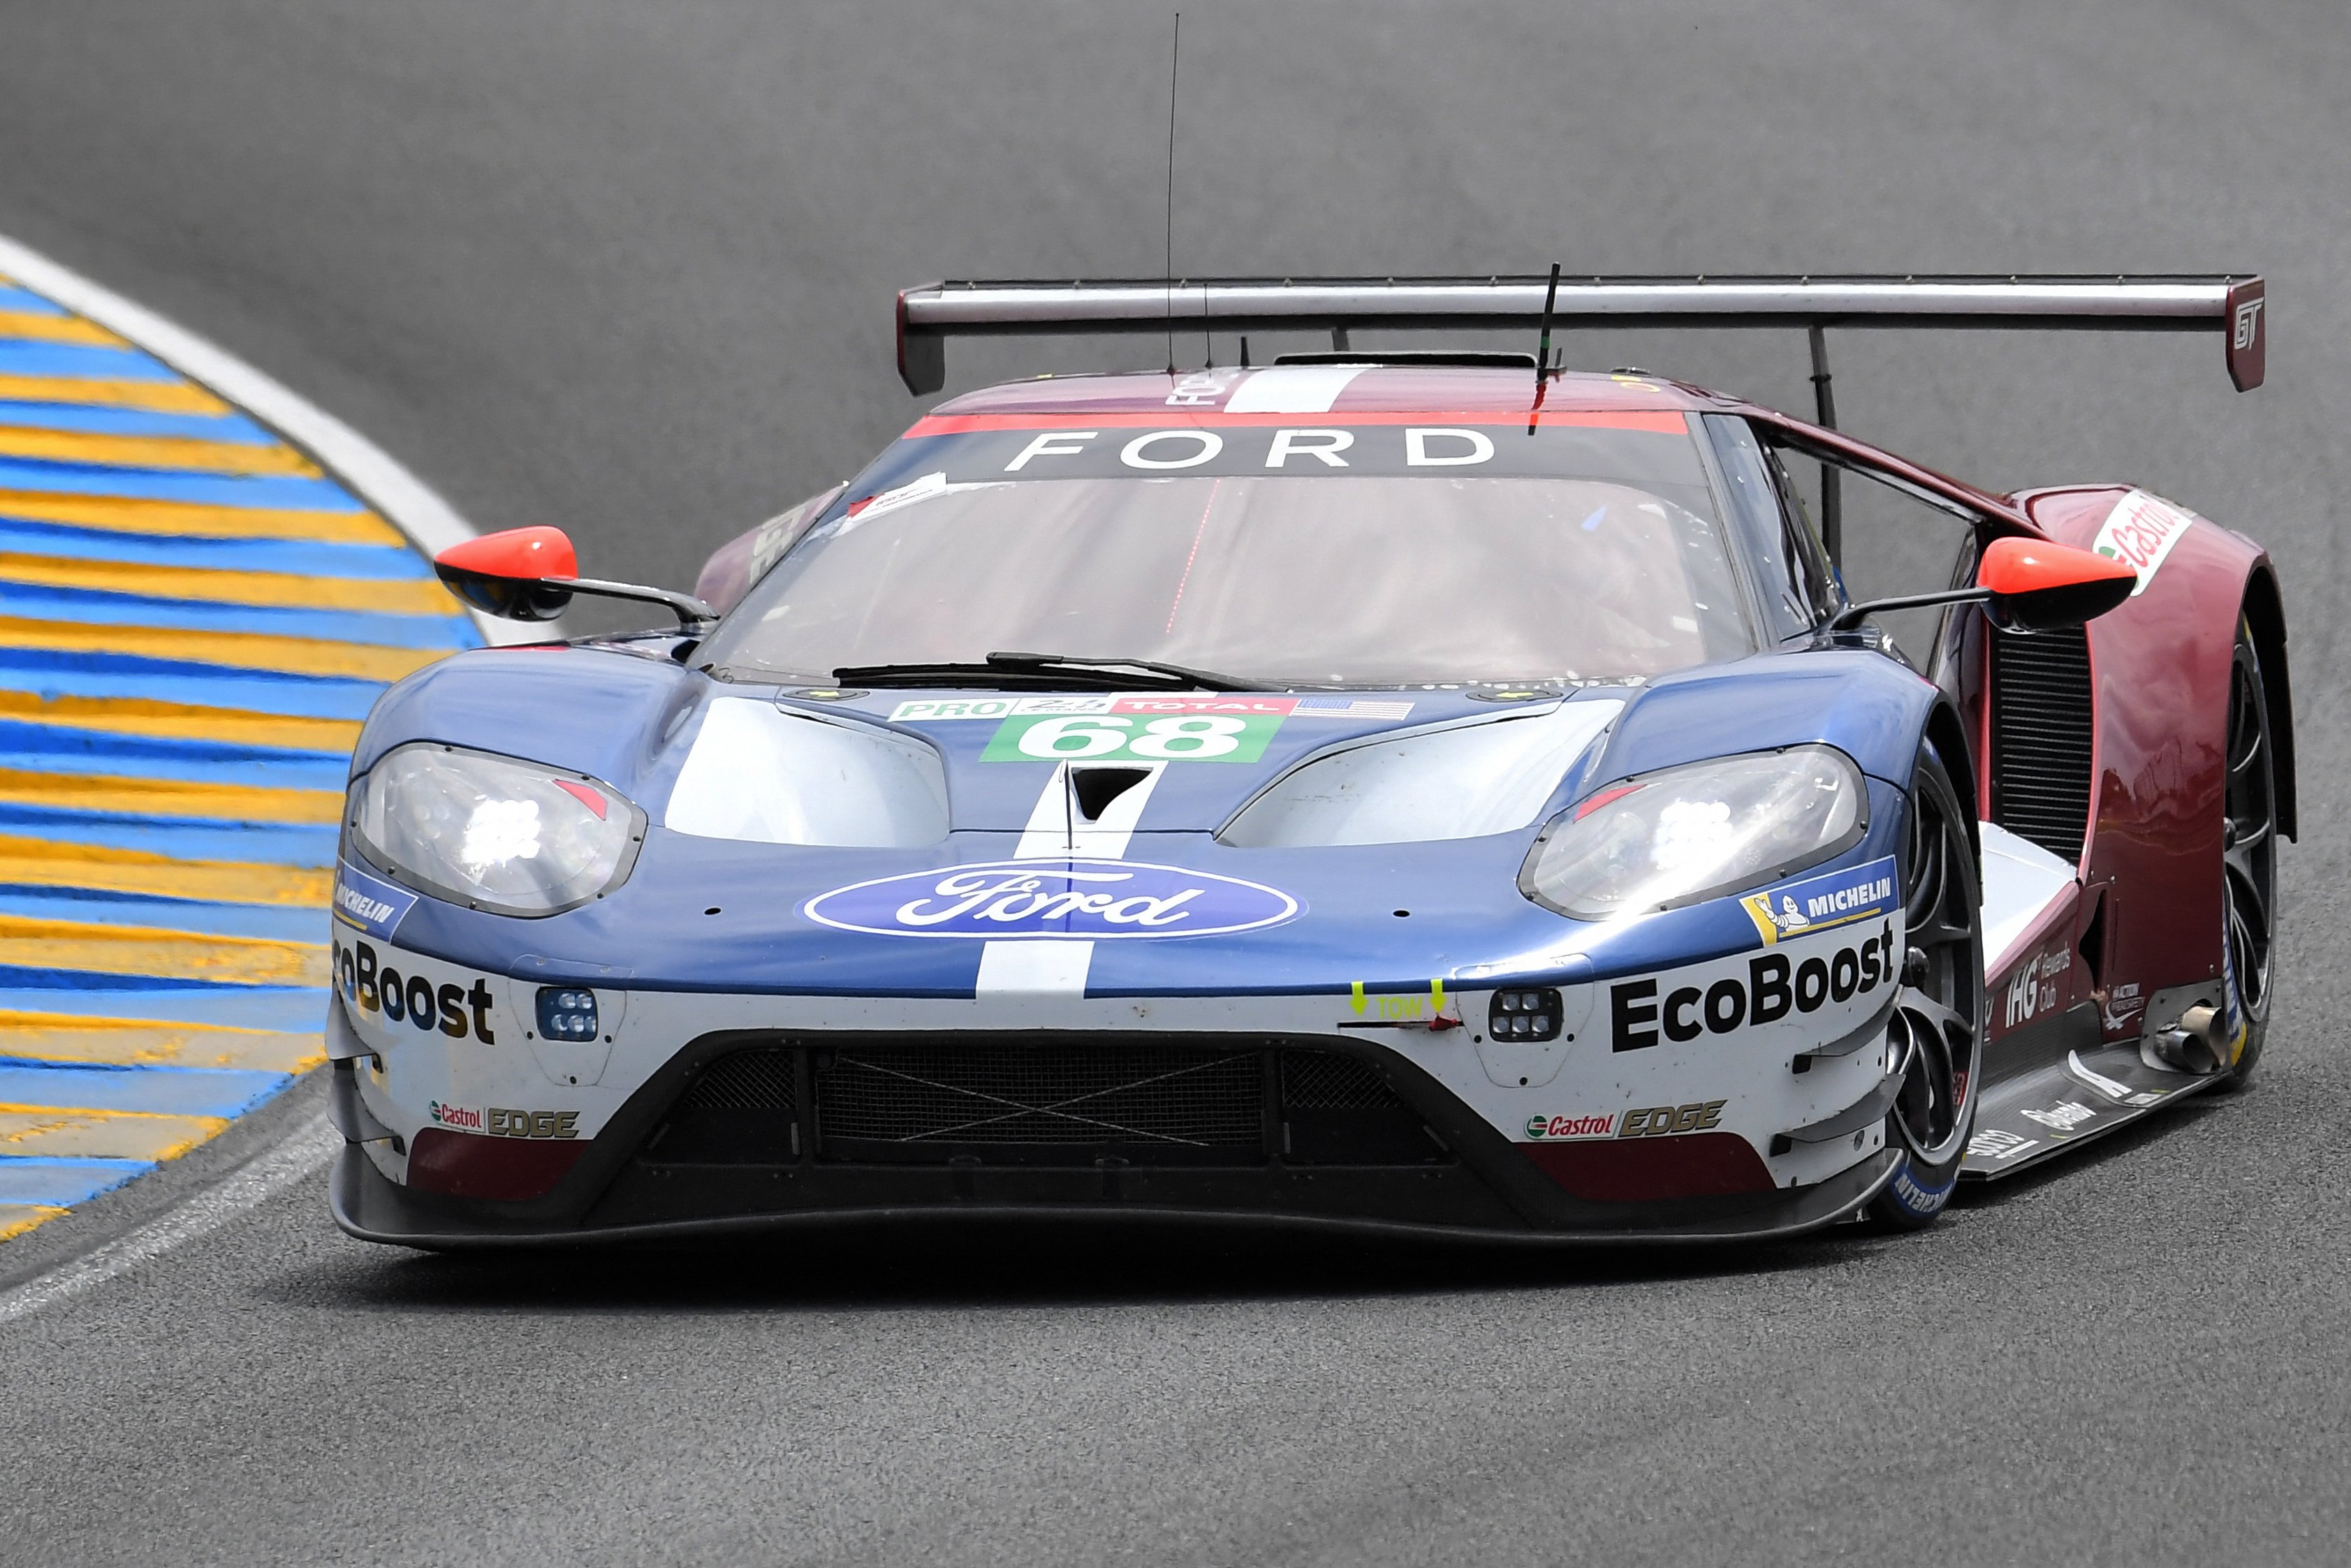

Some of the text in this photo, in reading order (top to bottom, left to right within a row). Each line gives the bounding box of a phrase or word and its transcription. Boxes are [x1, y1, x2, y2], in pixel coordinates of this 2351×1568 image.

[2234, 297, 2264, 351] GT
[1003, 427, 1496, 471] FORD
[898, 702, 1007, 717] PRO
[1124, 701, 1280, 711] TOTAL
[1018, 714, 1247, 759] 68
[335, 883, 395, 923] MICHELIN
[895, 869, 1206, 925] Ford
[1808, 877, 1891, 918] MICHELIN
[1610, 918, 1894, 1053] EcoBoost
[2005, 958, 2037, 1029] IHG
[1376, 996, 1423, 1020] TOW
[441, 1103, 580, 1138] Castrol EDGE
[1547, 1099, 1728, 1138] Castrol EDGE
